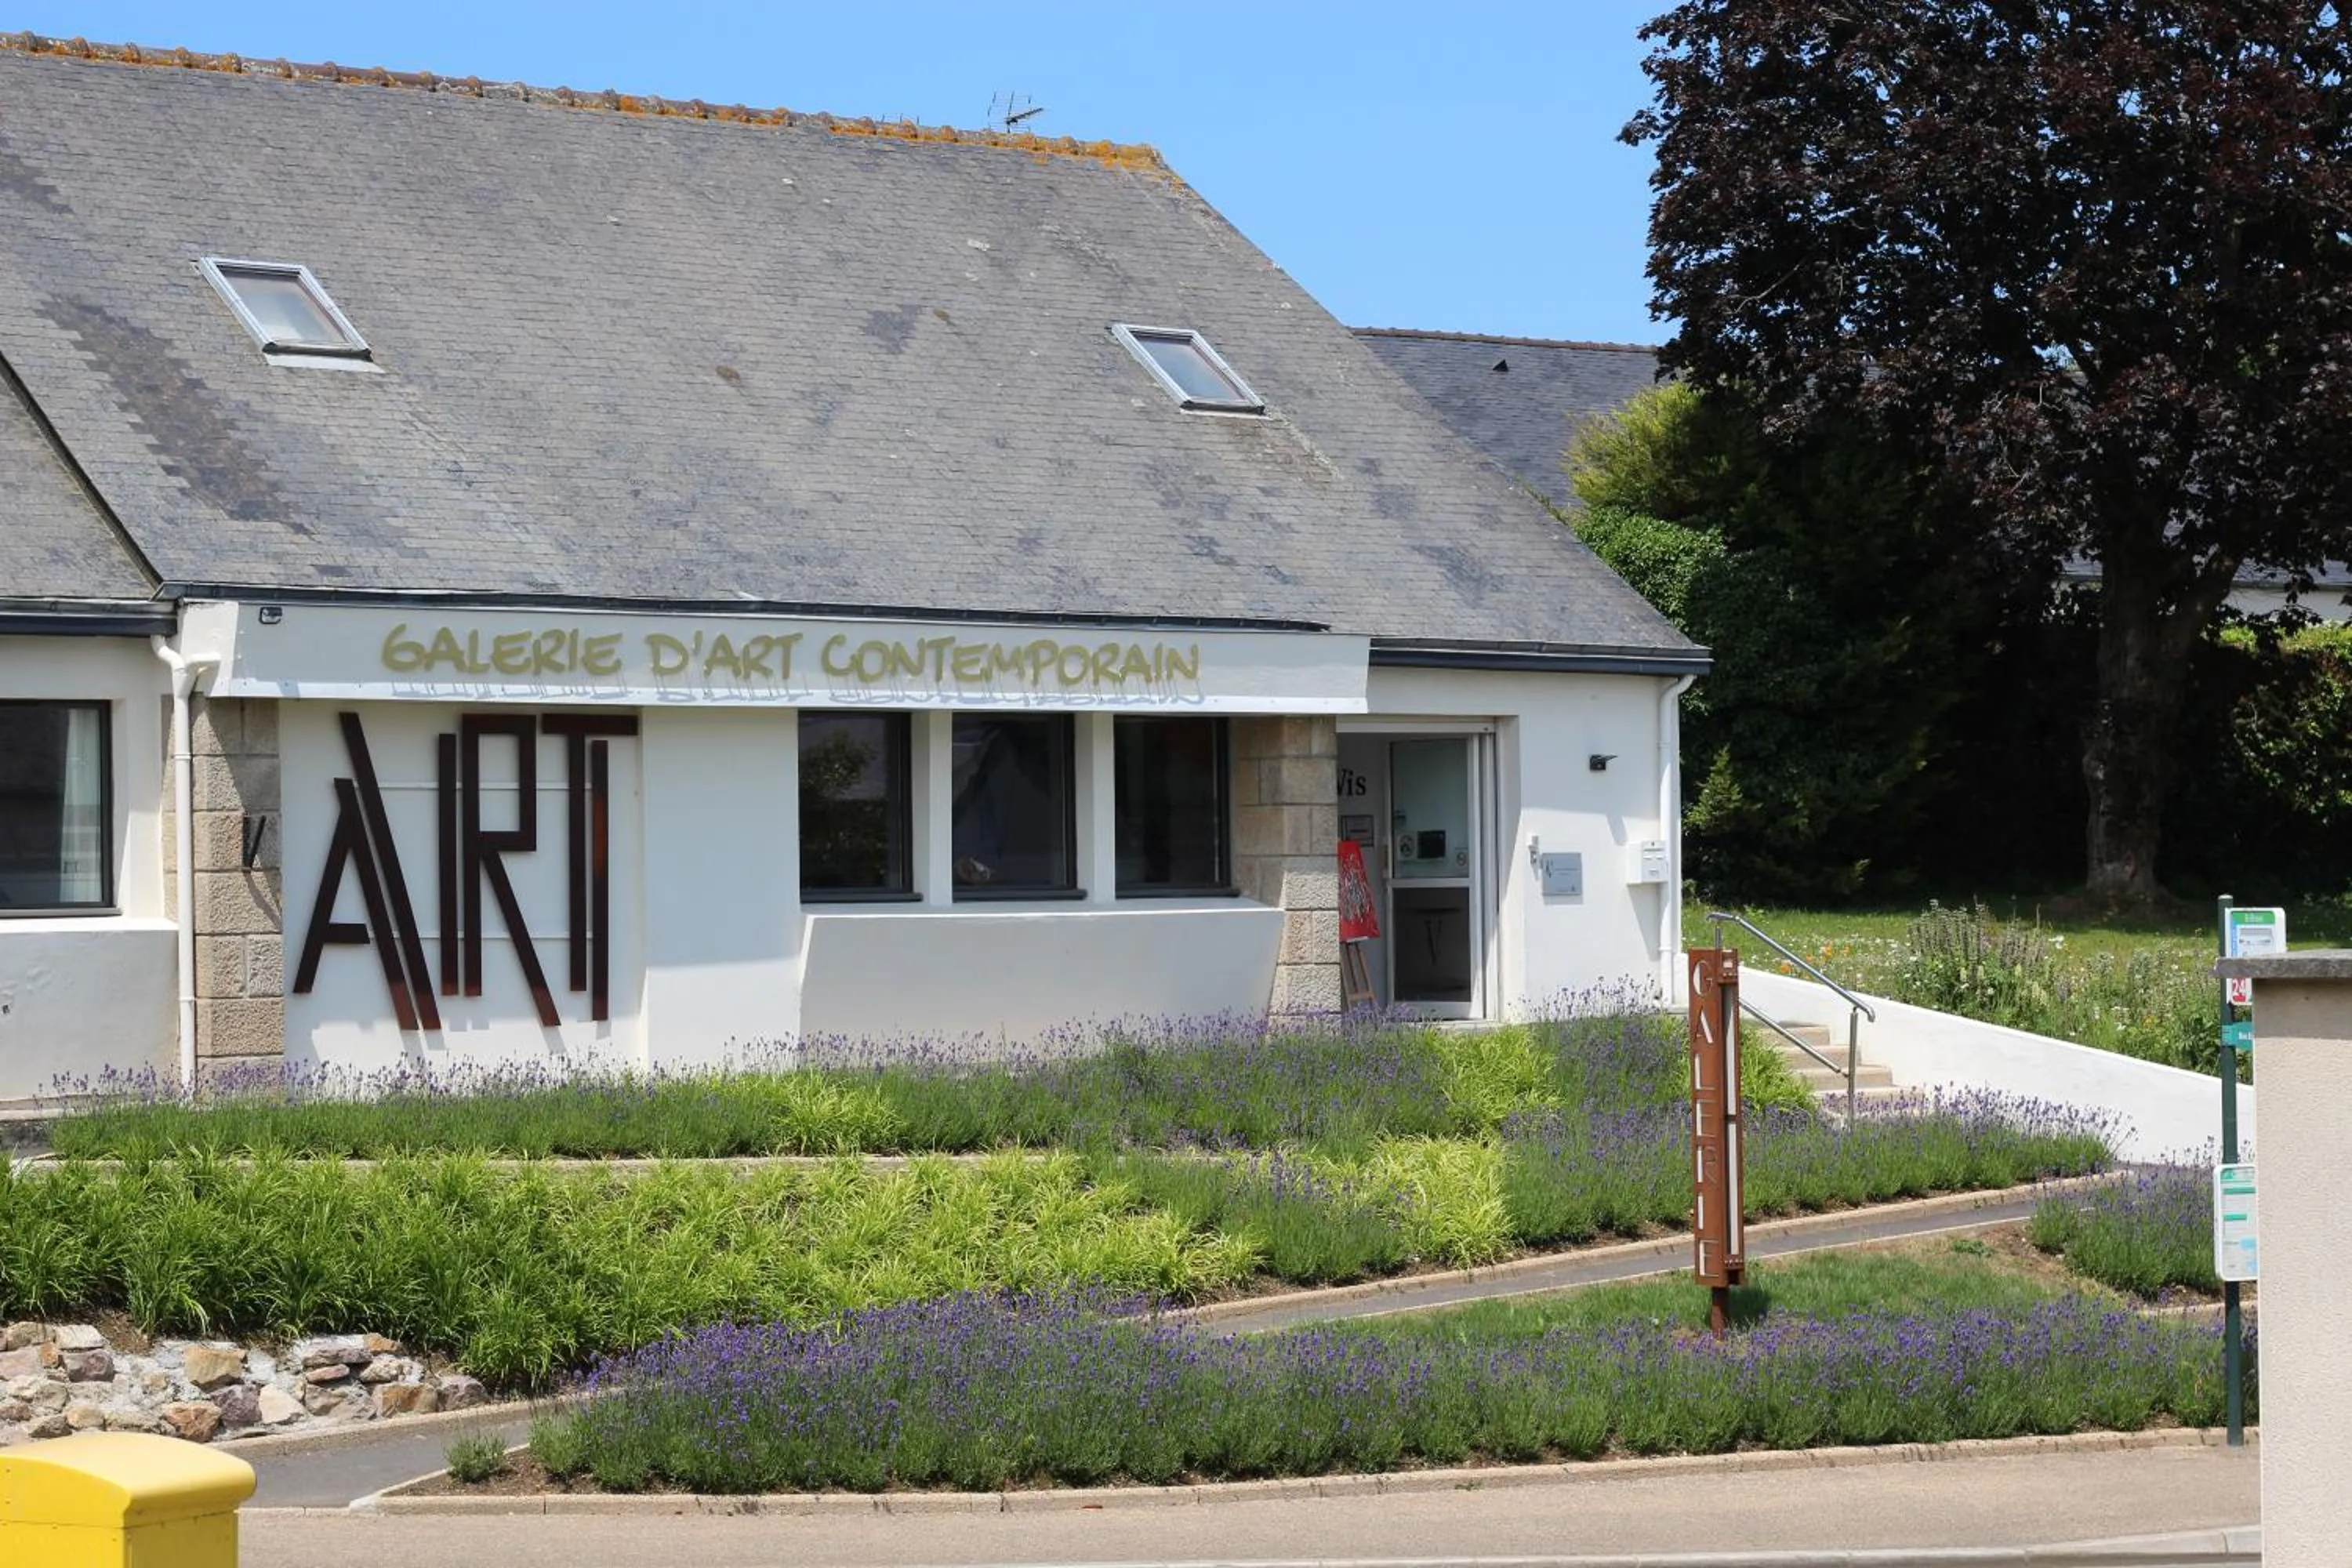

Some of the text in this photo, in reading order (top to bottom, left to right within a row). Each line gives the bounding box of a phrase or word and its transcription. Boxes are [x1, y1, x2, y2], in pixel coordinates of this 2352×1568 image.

[381, 624, 1200, 685] GALERIE D'ART CONTEMPORAIN
[293, 712, 638, 1030] ART
[1693, 959, 1719, 1277] GALERIE
